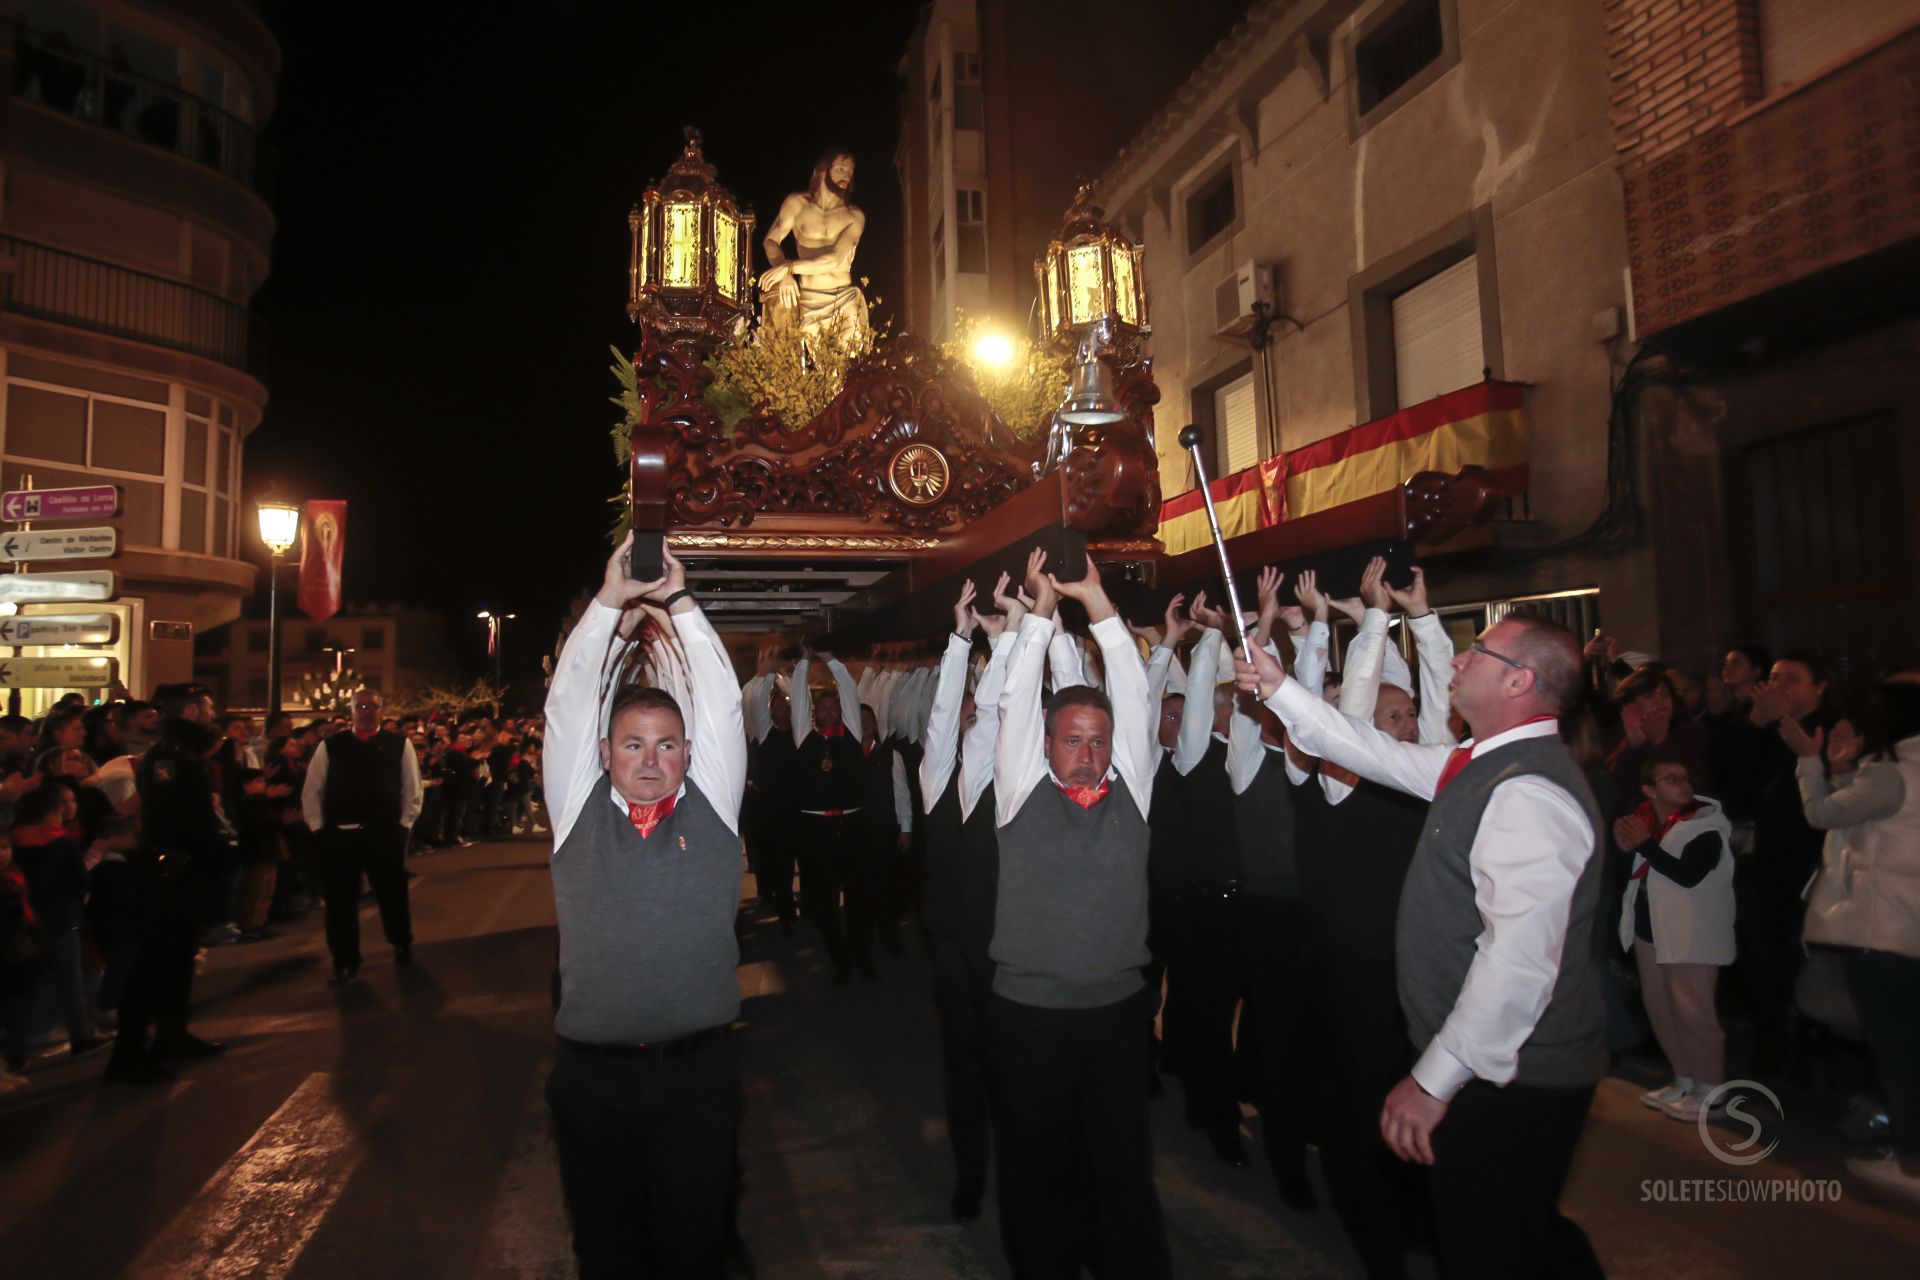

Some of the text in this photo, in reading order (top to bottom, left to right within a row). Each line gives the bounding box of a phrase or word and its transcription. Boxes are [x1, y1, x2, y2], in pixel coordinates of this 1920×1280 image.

[40, 534, 113, 545] Centro de Visitantes
[62, 624, 77, 633] San
[64, 664, 73, 672] de
